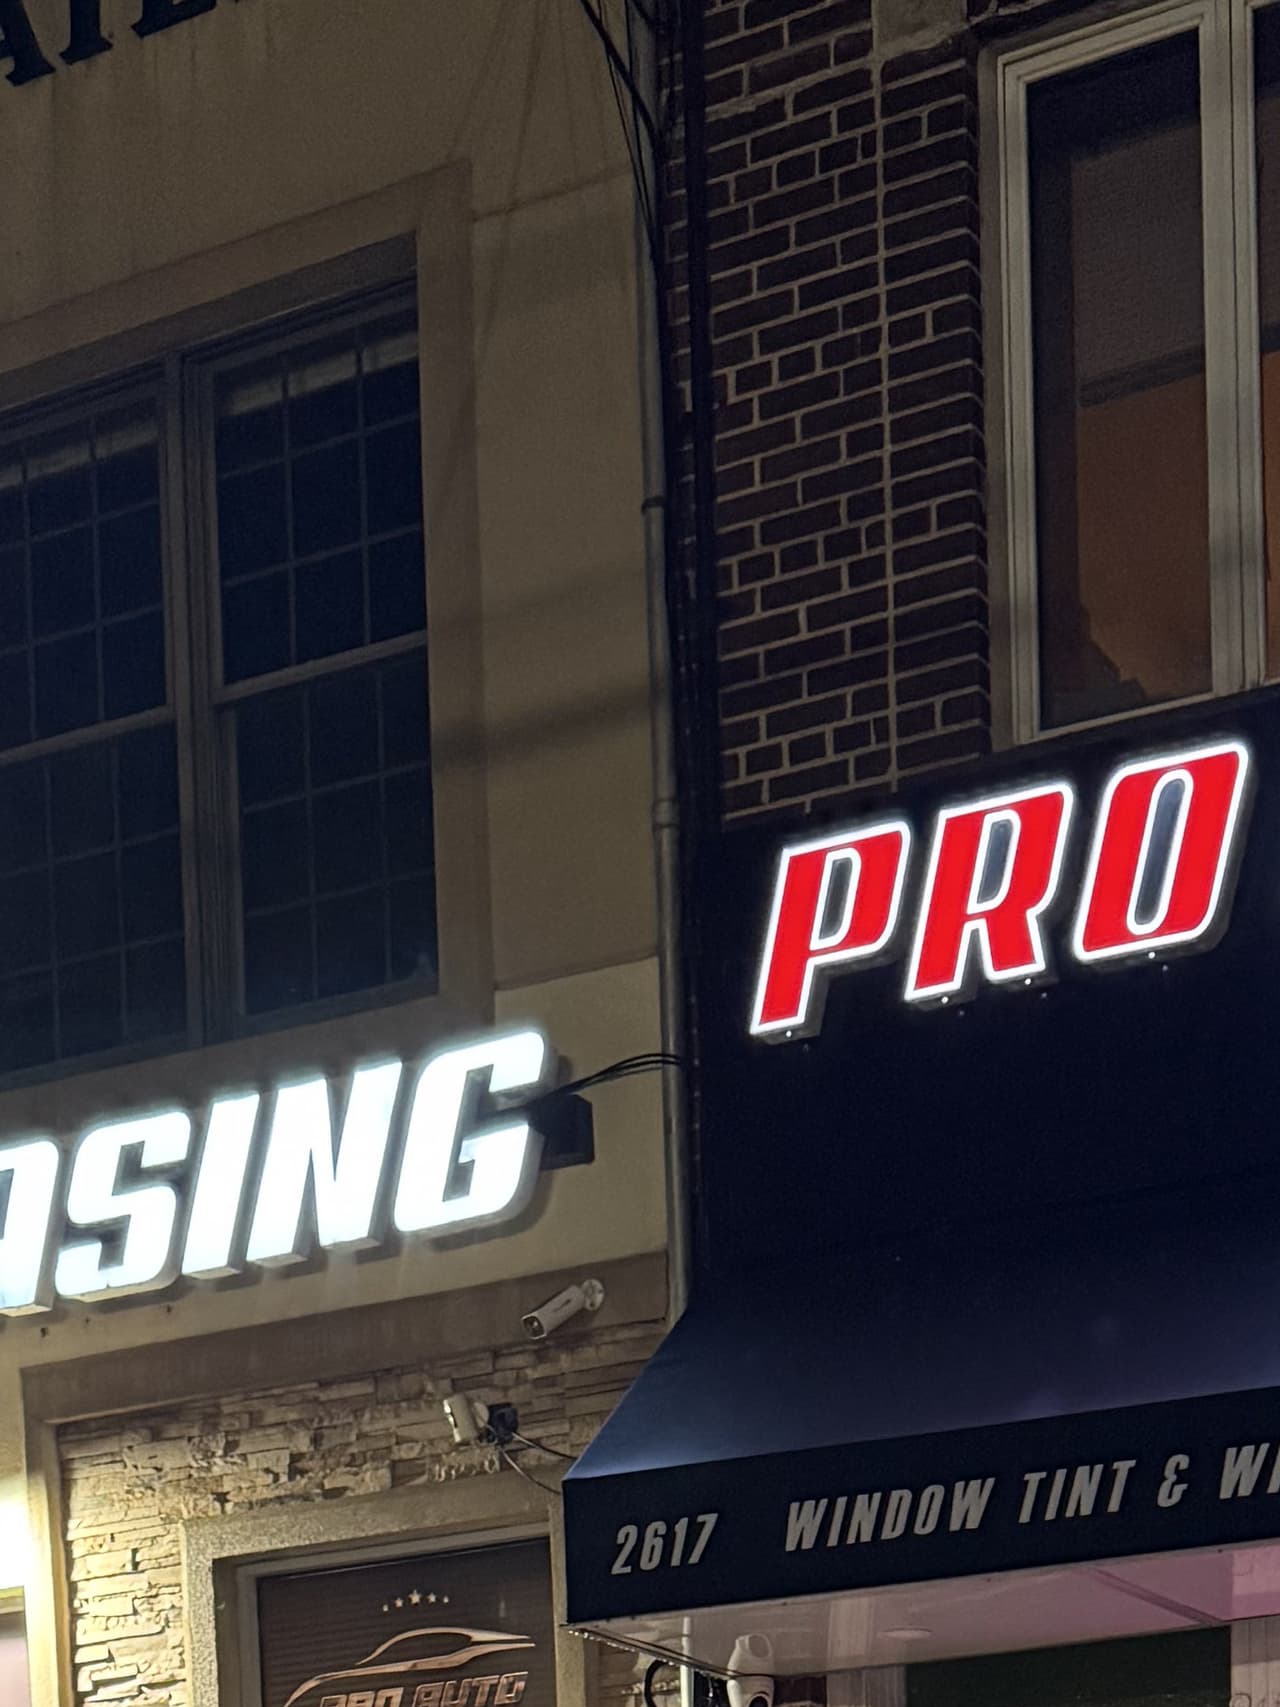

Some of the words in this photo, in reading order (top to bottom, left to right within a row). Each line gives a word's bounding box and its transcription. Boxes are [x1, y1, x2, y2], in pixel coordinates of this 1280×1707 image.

[750, 741, 1249, 1035] PRO
[611, 1512, 718, 1575] 2617
[784, 1477, 995, 1552] WINDOW
[1018, 1460, 1135, 1524] TINT
[1157, 1453, 1189, 1508] &
